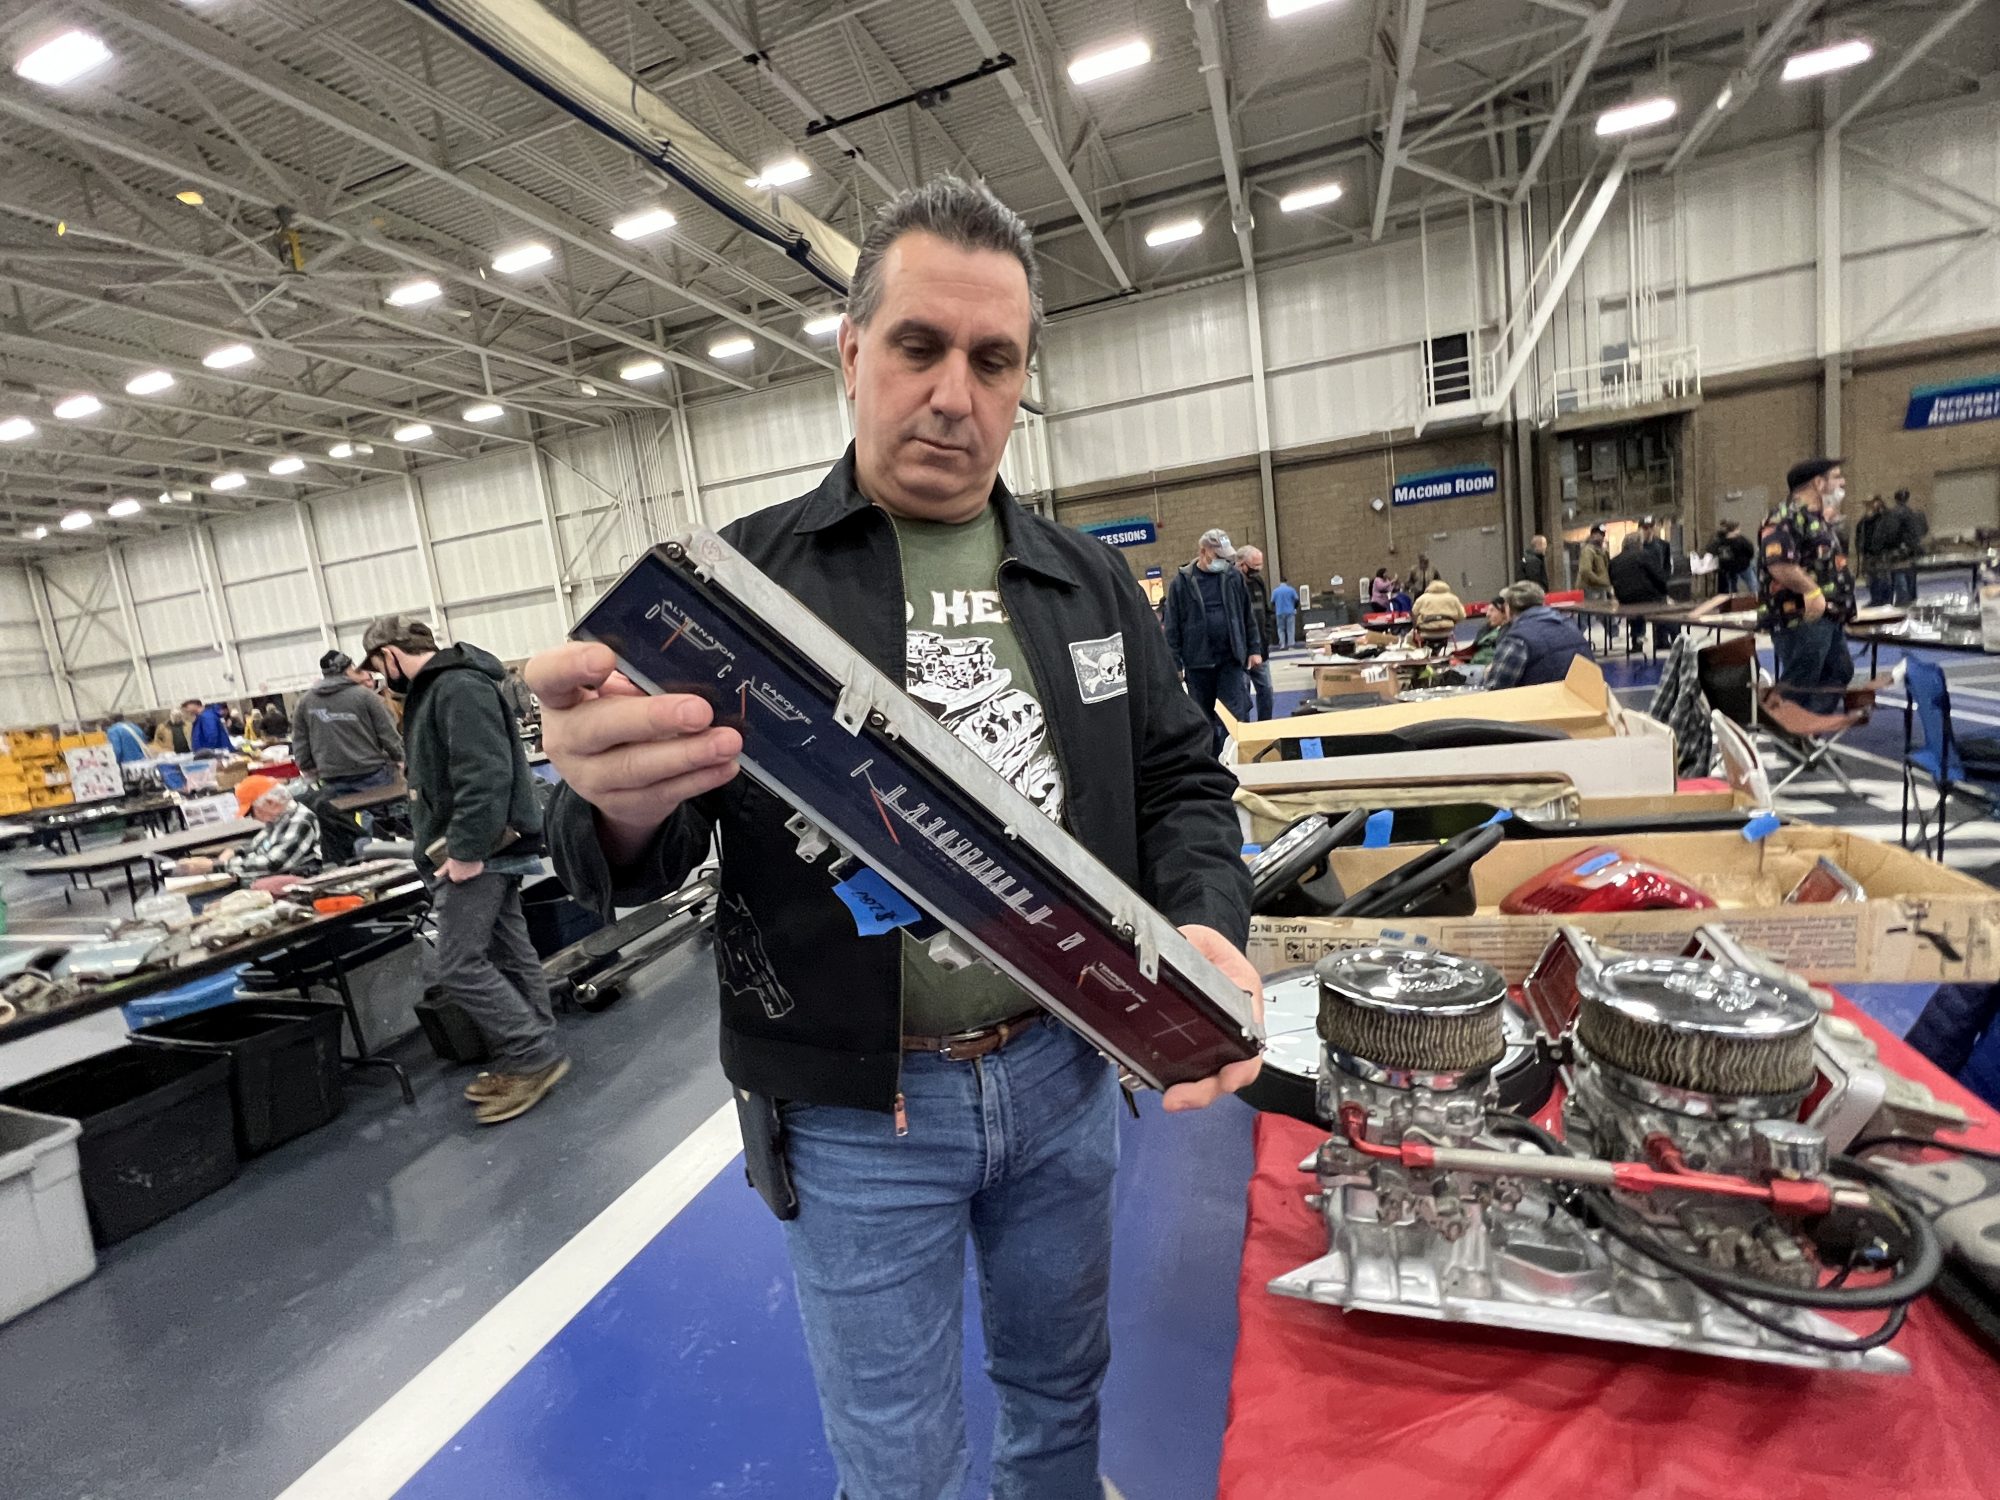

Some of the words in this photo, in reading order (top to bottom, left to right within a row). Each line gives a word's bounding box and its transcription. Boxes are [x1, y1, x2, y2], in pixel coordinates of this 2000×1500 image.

[1394, 482, 1452, 502] MACOMB
[1455, 475, 1494, 494] ROOM
[1097, 529, 1148, 545] CESSIONS
[930, 589, 1009, 627] HE
[663, 599, 736, 661] ALTERNATOR
[717, 664, 733, 679] C
[761, 682, 813, 725] GASOLINE
[801, 735, 816, 747] F
[850, 759, 874, 778] 0
[882, 784, 908, 805] 10
[903, 802, 931, 823] 20
[920, 816, 947, 838] 30
[1261, 924, 1272, 933] IN
[1275, 924, 1308, 934] MADE
